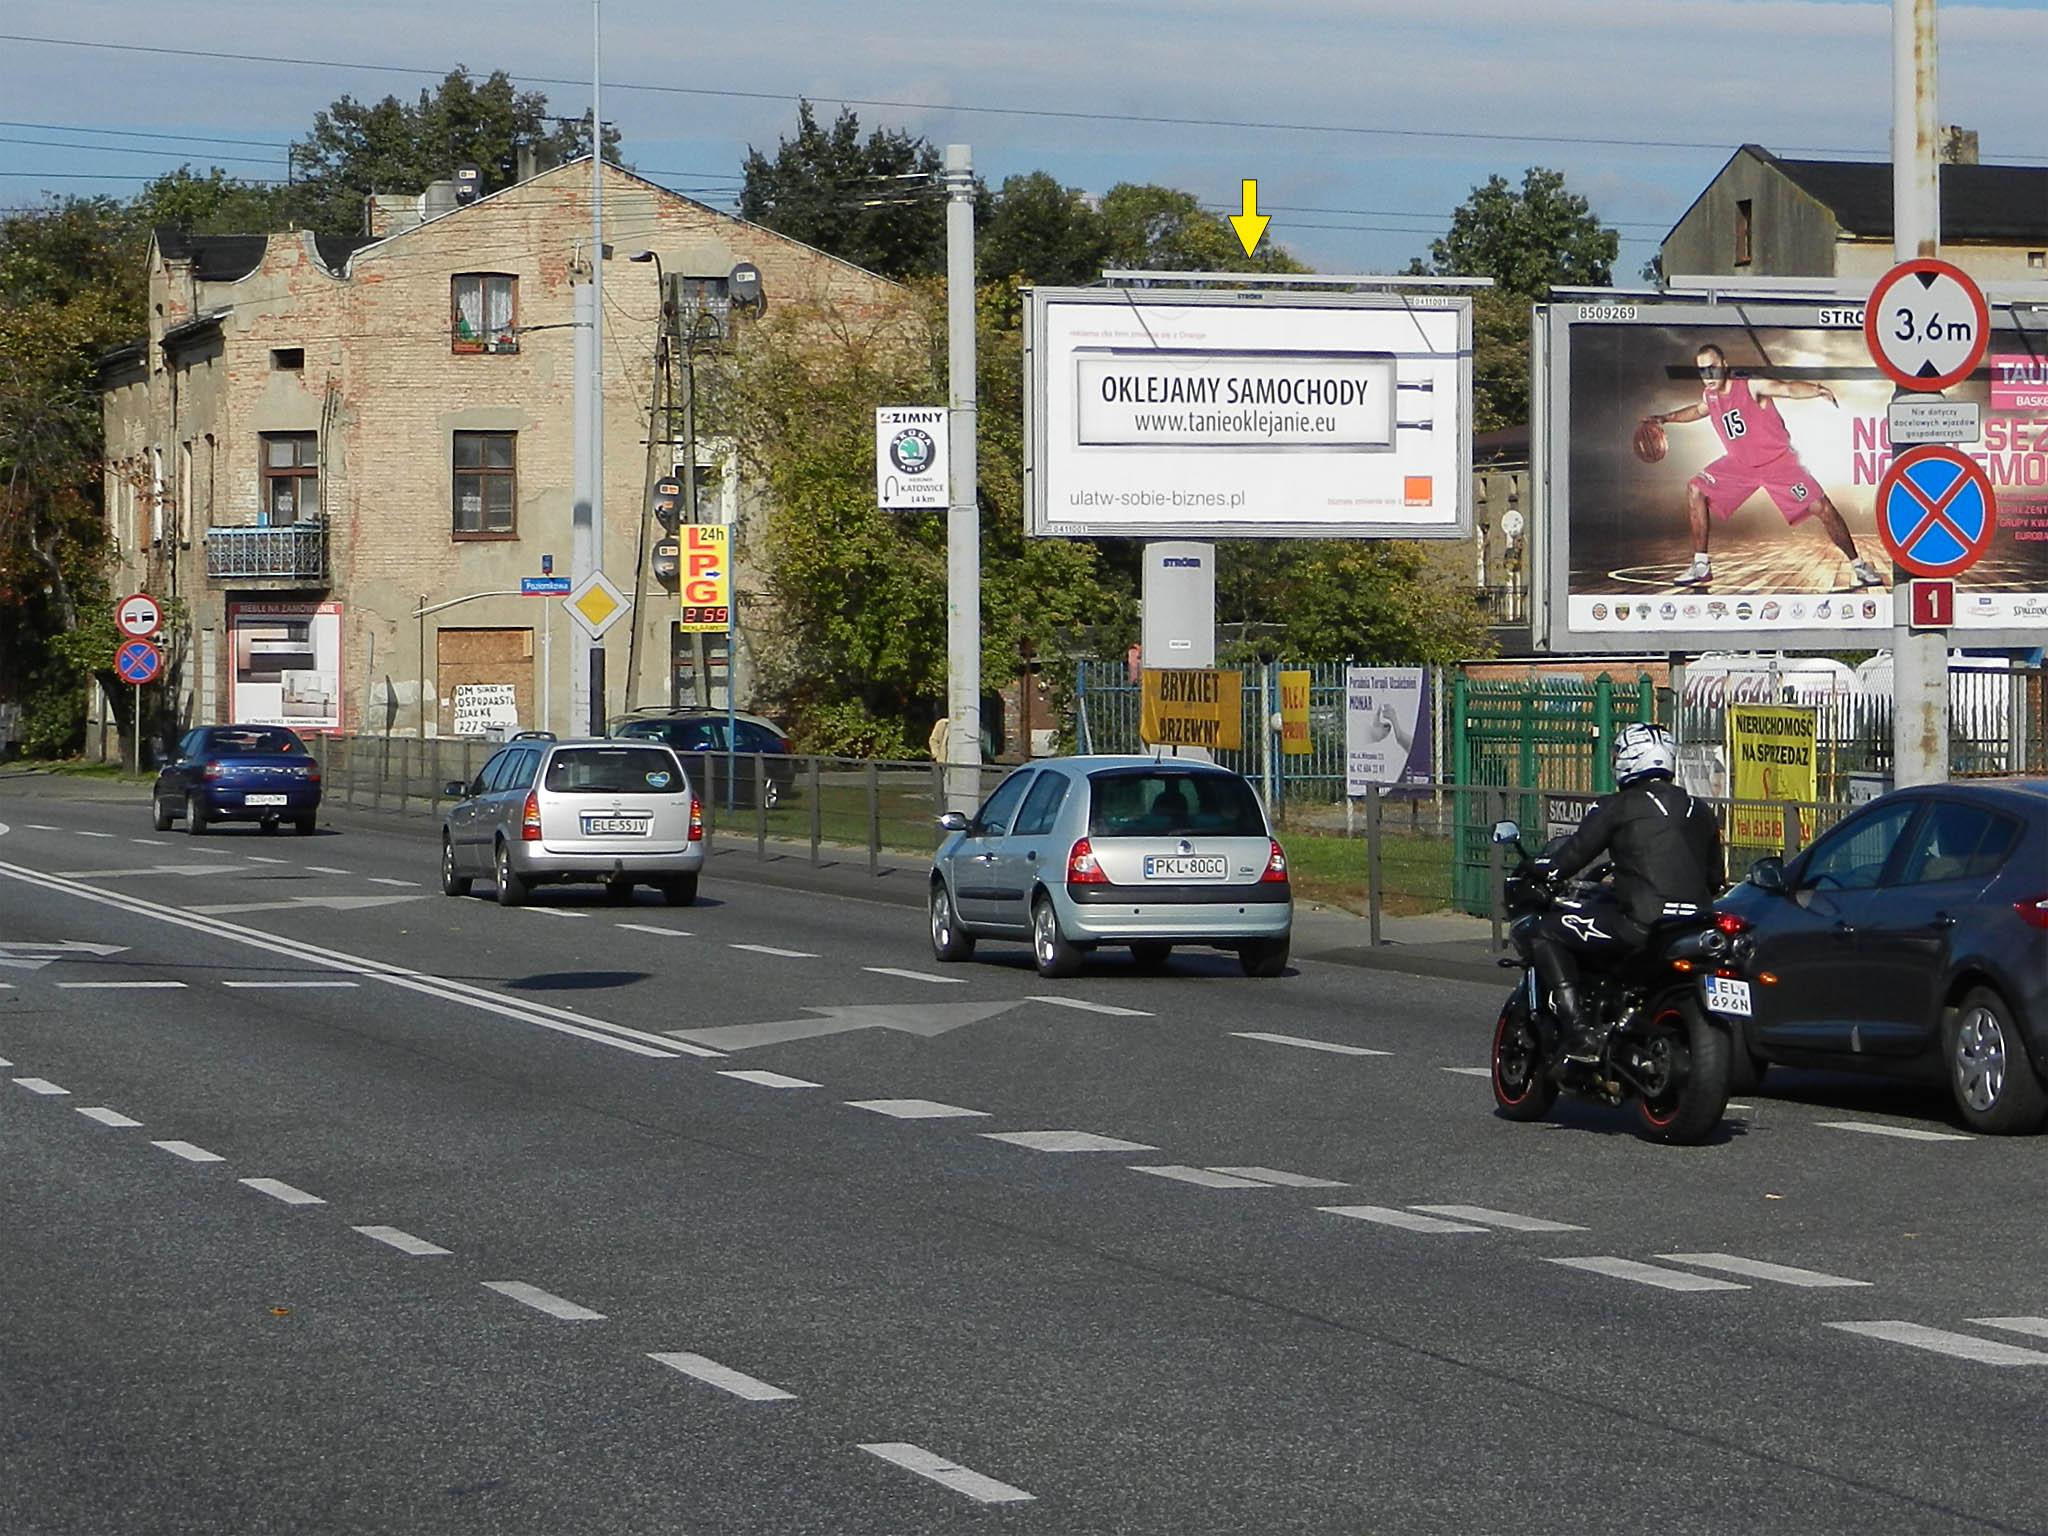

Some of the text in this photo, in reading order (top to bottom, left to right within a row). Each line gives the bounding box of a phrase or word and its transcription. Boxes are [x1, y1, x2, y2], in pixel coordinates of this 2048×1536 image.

[1579, 307, 1636, 319] 8509269
[1101, 376, 1368, 406] OKLEJAMY SAMOCHODY
[892, 412, 942, 423] ZIMNY
[1134, 409, 1336, 438] www.tanieoklejanie.eu
[1724, 410, 1746, 439] 15
[900, 464, 926, 472] AUTO
[900, 484, 945, 493] KATOWICE
[1792, 483, 1807, 501] 15
[911, 494, 936, 503] 14 km
[1069, 489, 1246, 508] ulatw-sobie-biznes.pl
[700, 527, 724, 541] 24h
[1928, 590, 1939, 619] 1
[1160, 672, 1220, 703] BRYKIET
[1160, 718, 1220, 744] DRZEWNY
[1735, 712, 1814, 738] NIERUCHOMOŚĆ
[1742, 742, 1809, 766] NA SPRZEDAŻ
[1549, 800, 1583, 823] SKŁAD
[592, 820, 617, 831] ELE
[1156, 859, 1223, 873] PKL 80GC
[1720, 981, 1739, 995] EL
[1711, 995, 1749, 1012] 696N
